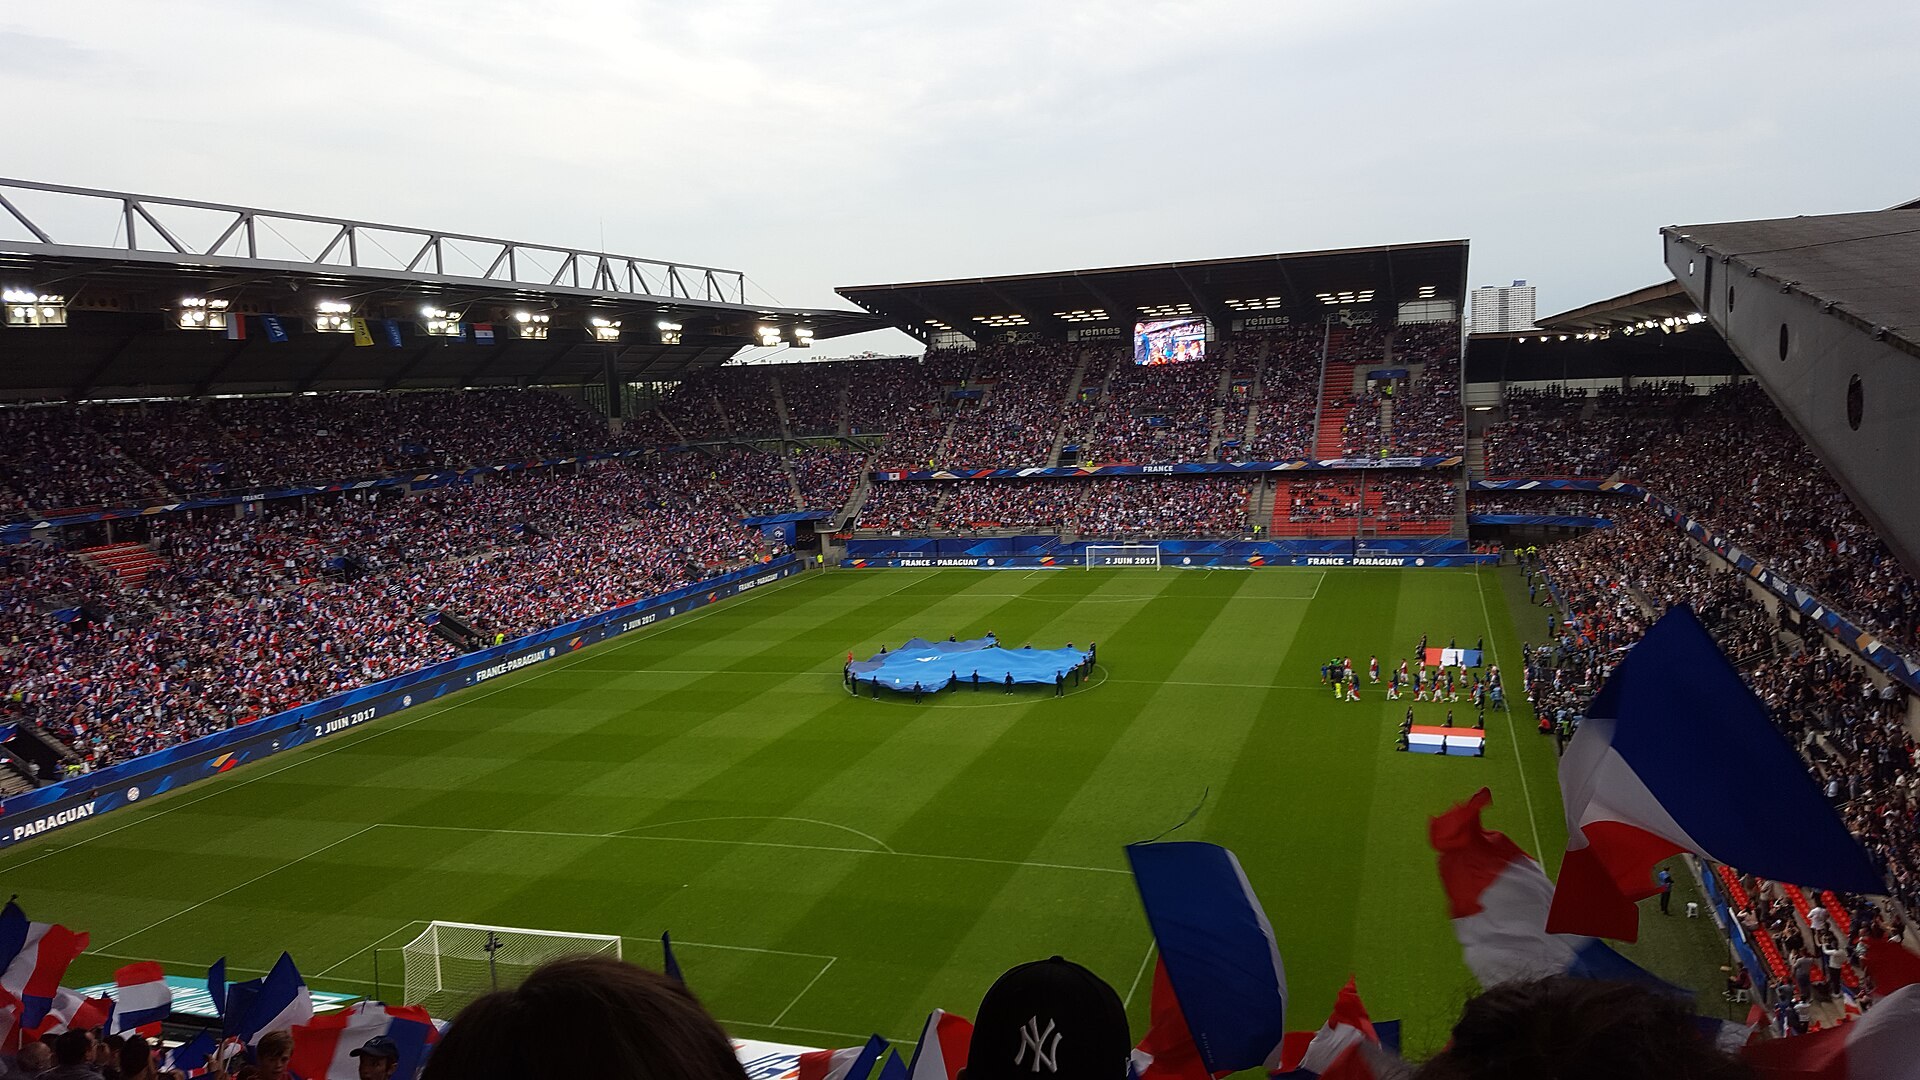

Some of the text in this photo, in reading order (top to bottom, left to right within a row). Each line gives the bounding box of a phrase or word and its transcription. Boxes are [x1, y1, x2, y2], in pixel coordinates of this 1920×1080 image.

[1245, 315, 1290, 326] rennes
[1080, 326, 1121, 337] rennes
[1142, 465, 1174, 473] FRANCE
[1105, 557, 1156, 565] 2 JUIN 2017
[1307, 558, 1345, 566] FRANCE
[1353, 558, 1405, 566] PARAGUAY
[622, 613, 656, 632] 2 JUIN 2017
[314, 707, 376, 737] 2 JUIN 2017
[13, 801, 96, 841] PARAGUAY
[1014, 1015, 1063, 1073] NY
